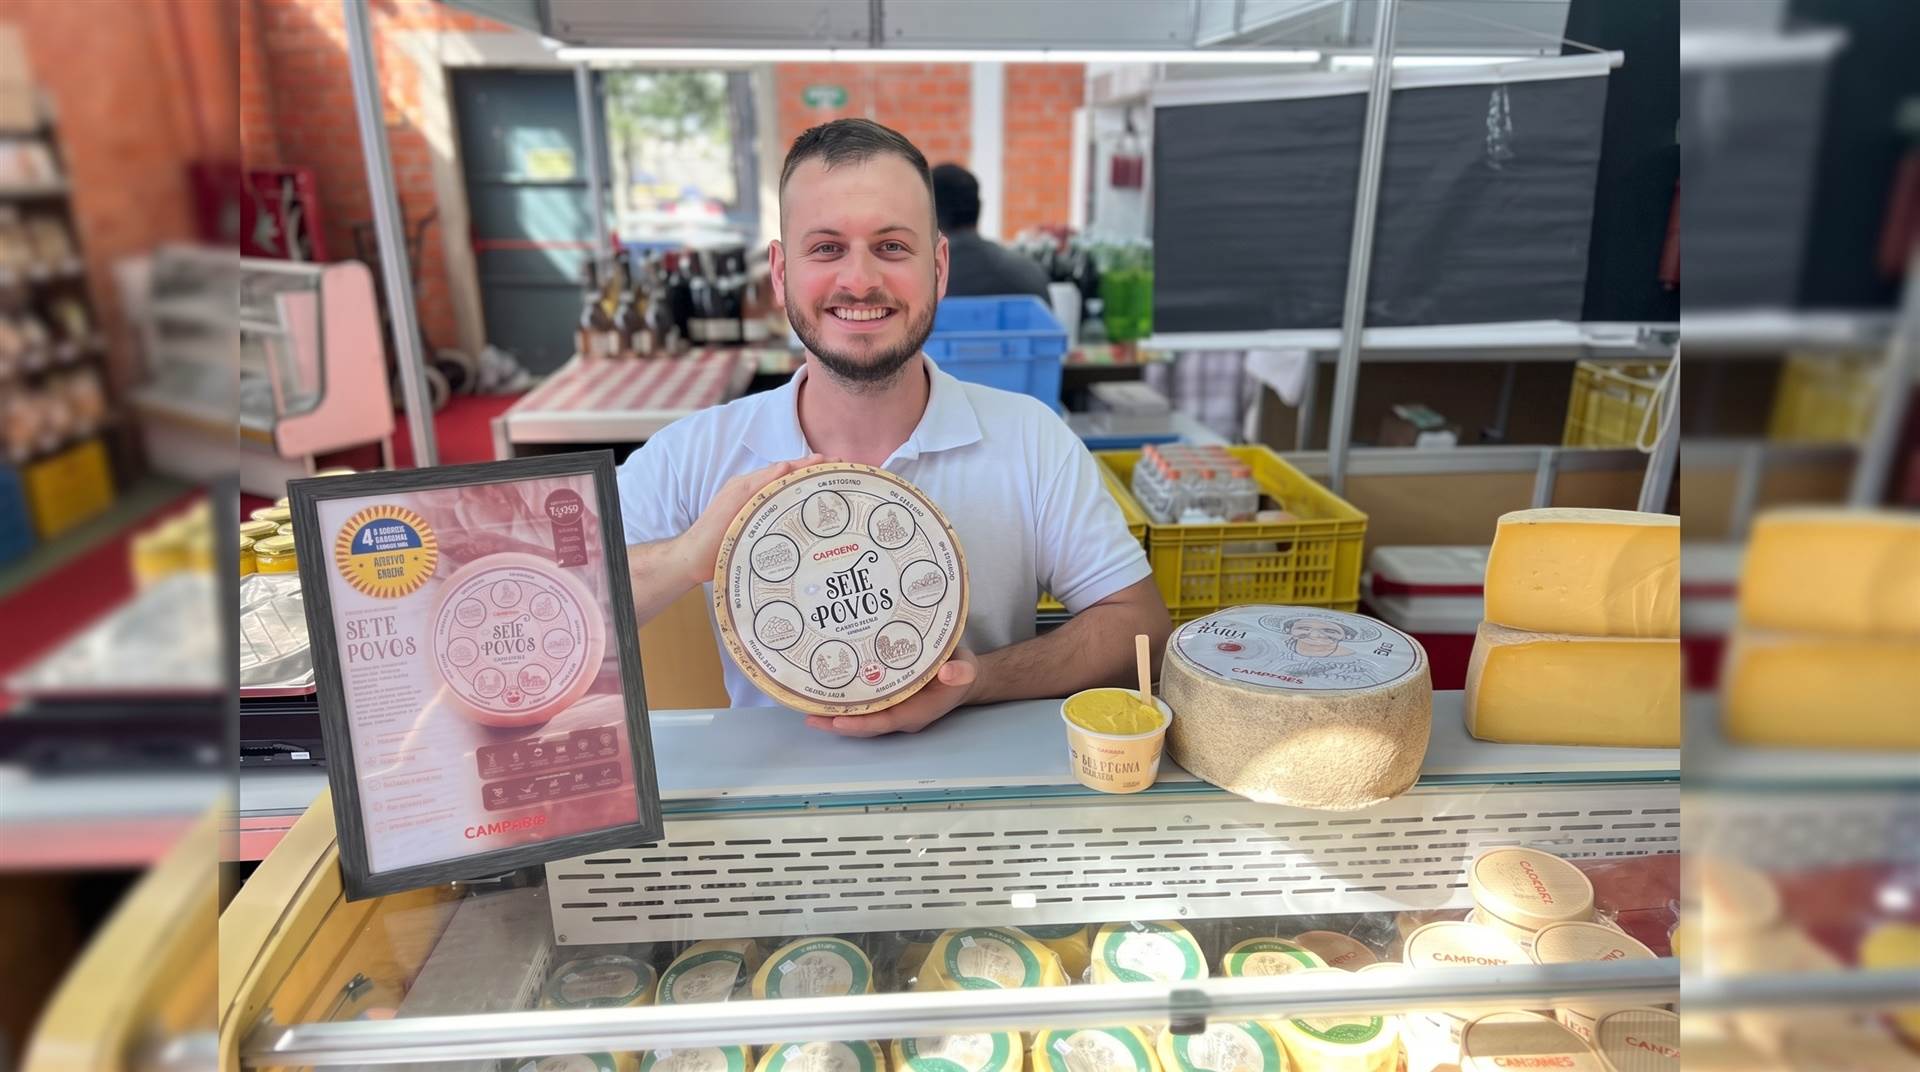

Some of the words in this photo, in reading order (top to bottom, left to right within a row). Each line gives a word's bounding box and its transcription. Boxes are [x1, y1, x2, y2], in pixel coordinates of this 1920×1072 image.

[825, 550, 879, 600] SETE
[811, 588, 893, 629] POVOS
[346, 615, 398, 640] SETE
[347, 636, 417, 663] POVOS
[480, 637, 536, 656] POVOS
